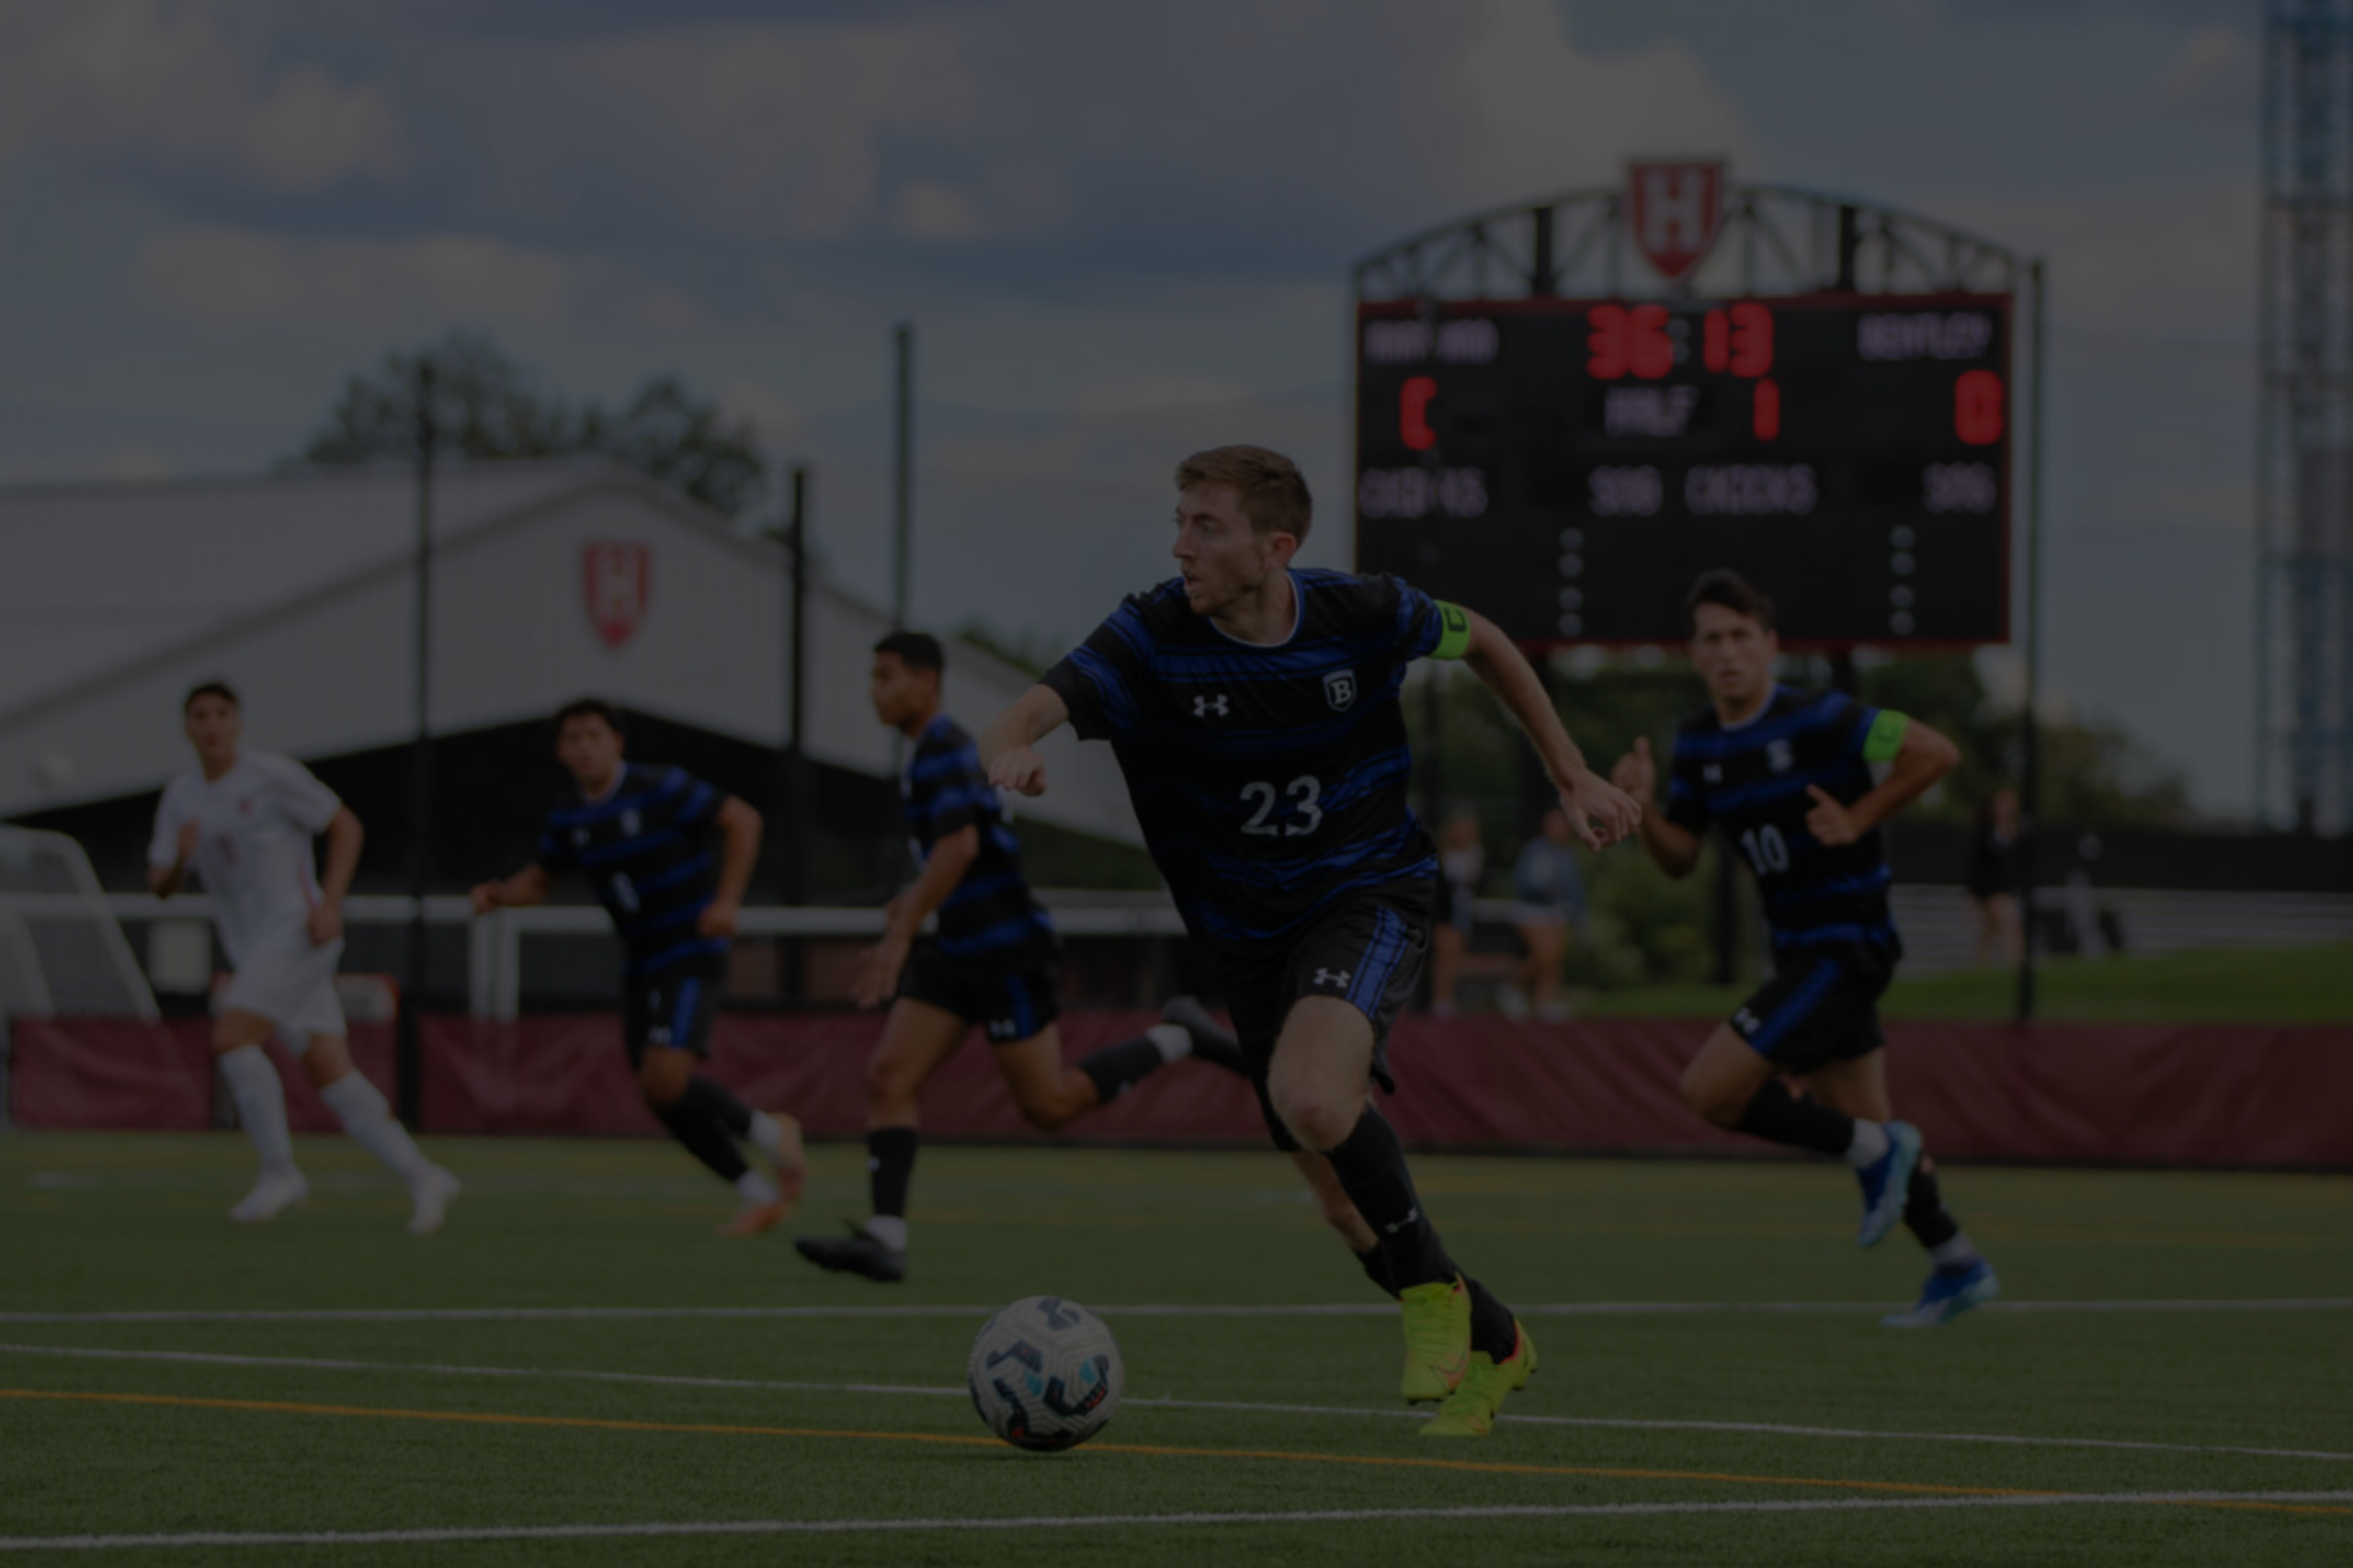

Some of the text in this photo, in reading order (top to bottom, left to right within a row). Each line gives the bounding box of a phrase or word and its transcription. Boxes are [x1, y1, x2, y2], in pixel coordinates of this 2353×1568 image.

[1643, 169, 1704, 254] H
[1954, 369, 2004, 445] 0
[1330, 678, 1353, 706] B
[1239, 775, 1324, 838] 23
[1741, 823, 1790, 877] 10
